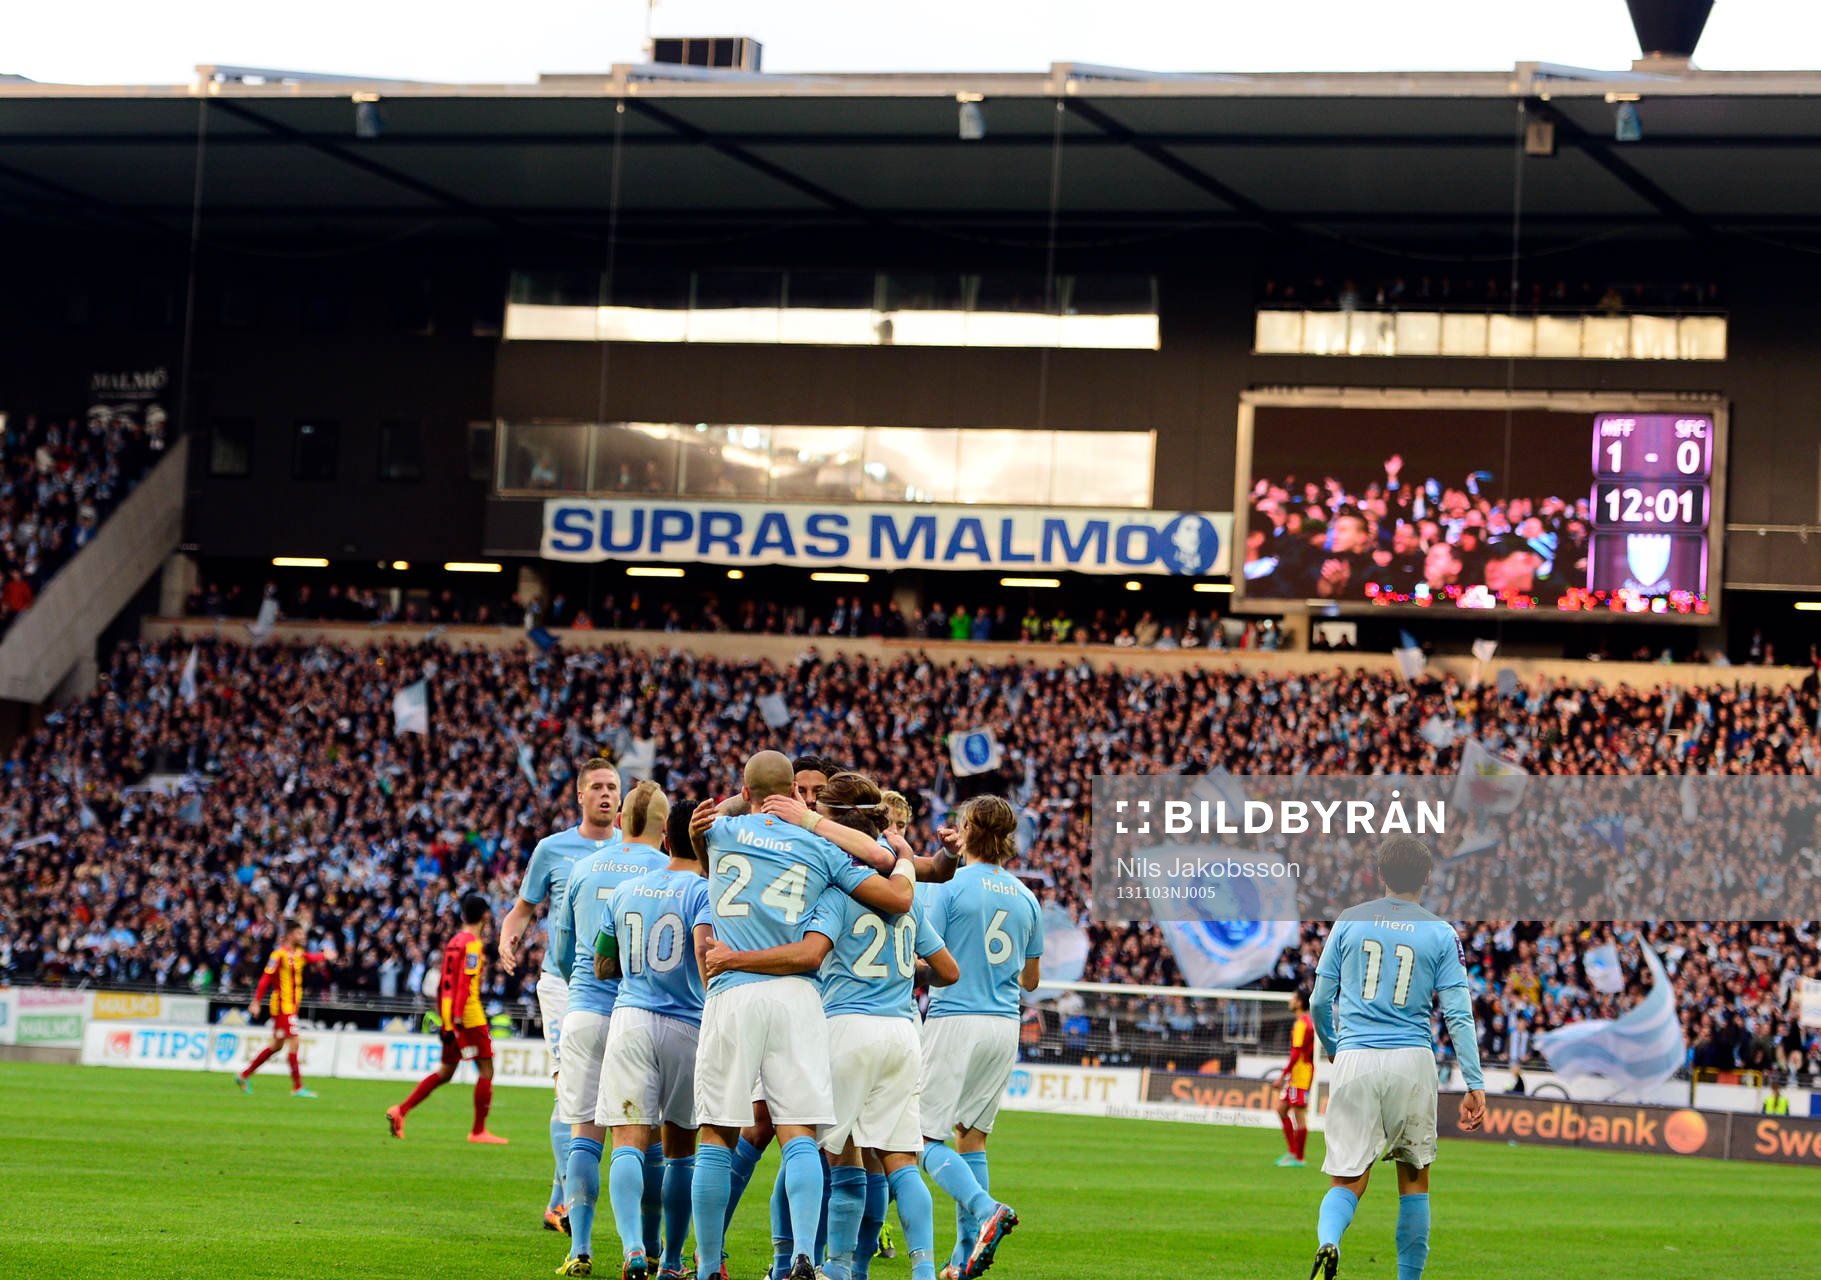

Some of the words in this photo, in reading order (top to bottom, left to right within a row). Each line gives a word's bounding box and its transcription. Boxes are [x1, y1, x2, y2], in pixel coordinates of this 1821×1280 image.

[1675, 420, 1705, 438] SFC
[1607, 440, 1622, 473] 1
[1677, 440, 1700, 474] 0
[1605, 488, 1693, 523] 12:01
[550, 507, 852, 558] SUPRAS
[737, 828, 793, 852] Molins
[591, 860, 648, 875] Eriksson
[716, 853, 808, 924] 24
[982, 877, 1018, 897] Halsti
[984, 908, 1014, 965] 6
[1373, 914, 1415, 934] Thern
[624, 911, 686, 974] 10
[852, 913, 917, 979] 20
[1362, 939, 1415, 1007] 11
[137, 1030, 207, 1060] TIPS
[391, 1042, 443, 1072] TIP
[501, 1048, 550, 1076] ELI
[1037, 1073, 1118, 1101] ELIT
[1480, 1104, 1657, 1147] wedbank
